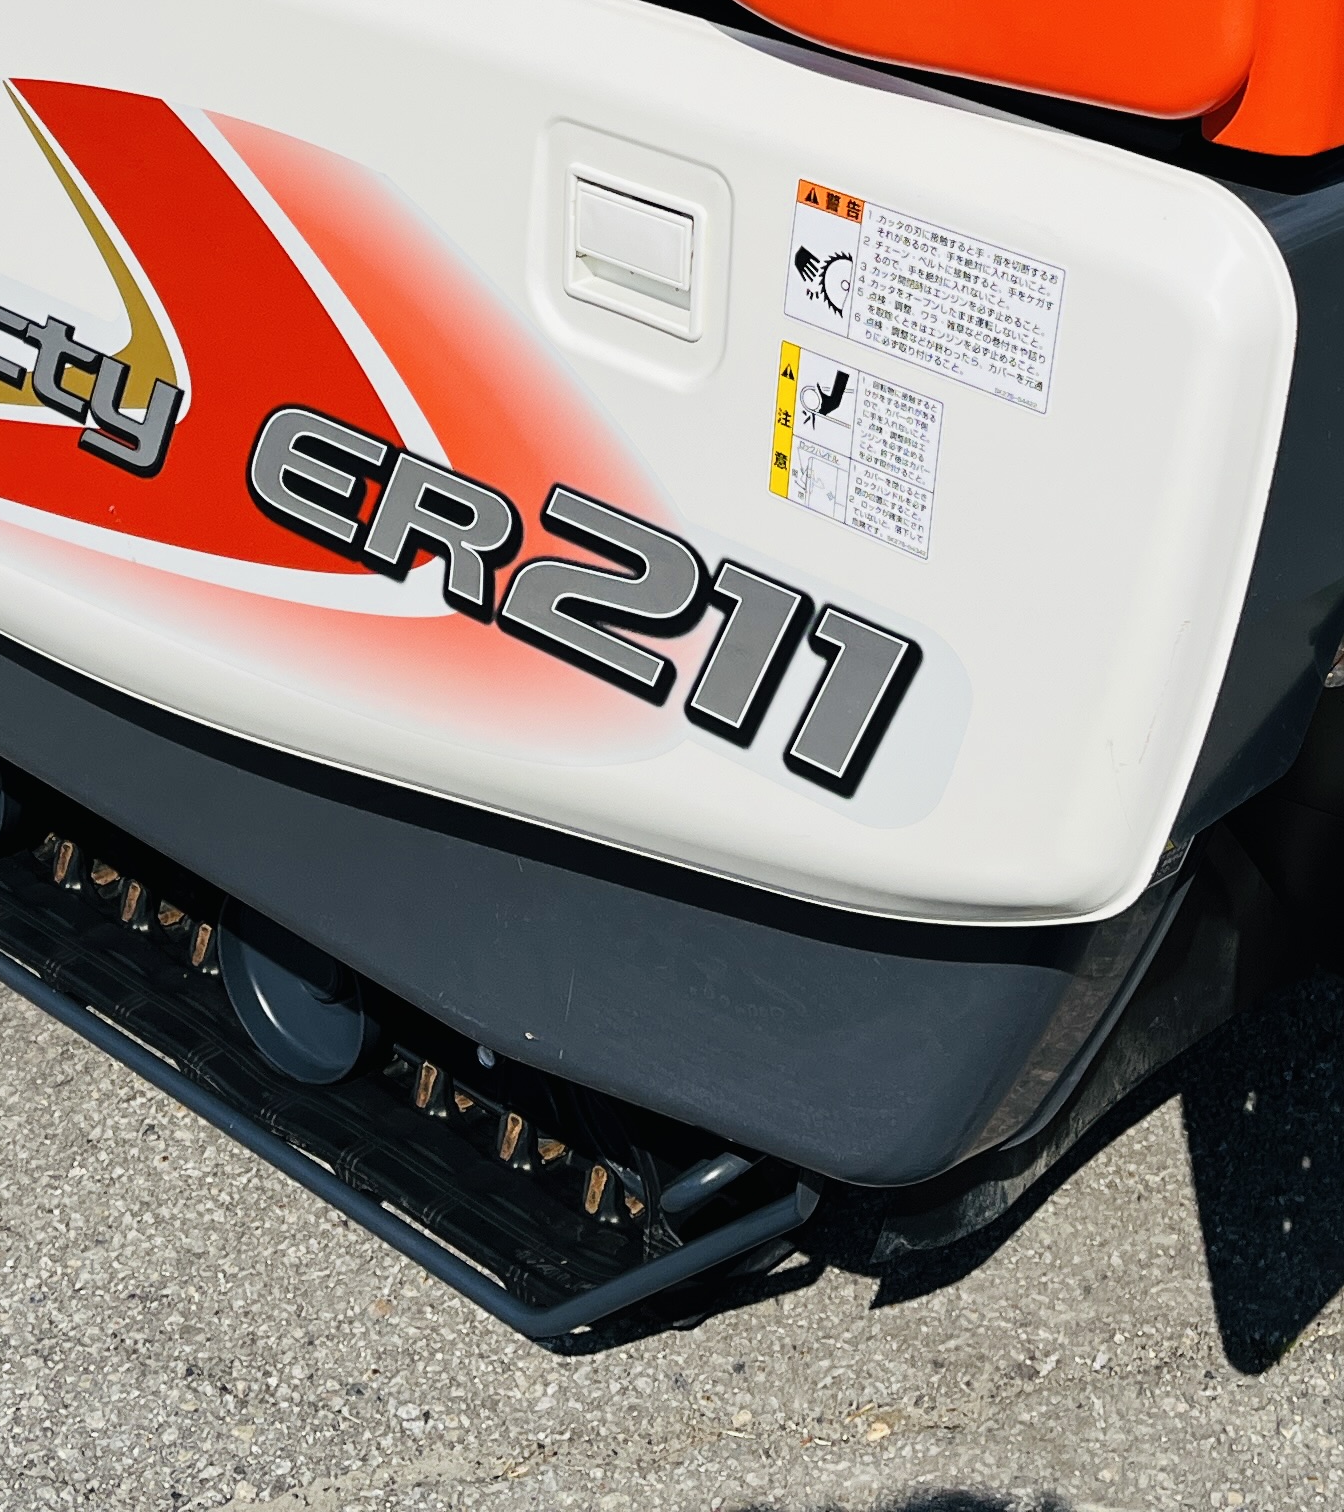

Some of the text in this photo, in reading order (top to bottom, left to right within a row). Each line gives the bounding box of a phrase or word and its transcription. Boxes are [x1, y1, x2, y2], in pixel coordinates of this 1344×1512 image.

[825, 190, 862, 221] 警告
[773, 407, 793, 471] 注意
[247, 404, 923, 799] ER211
